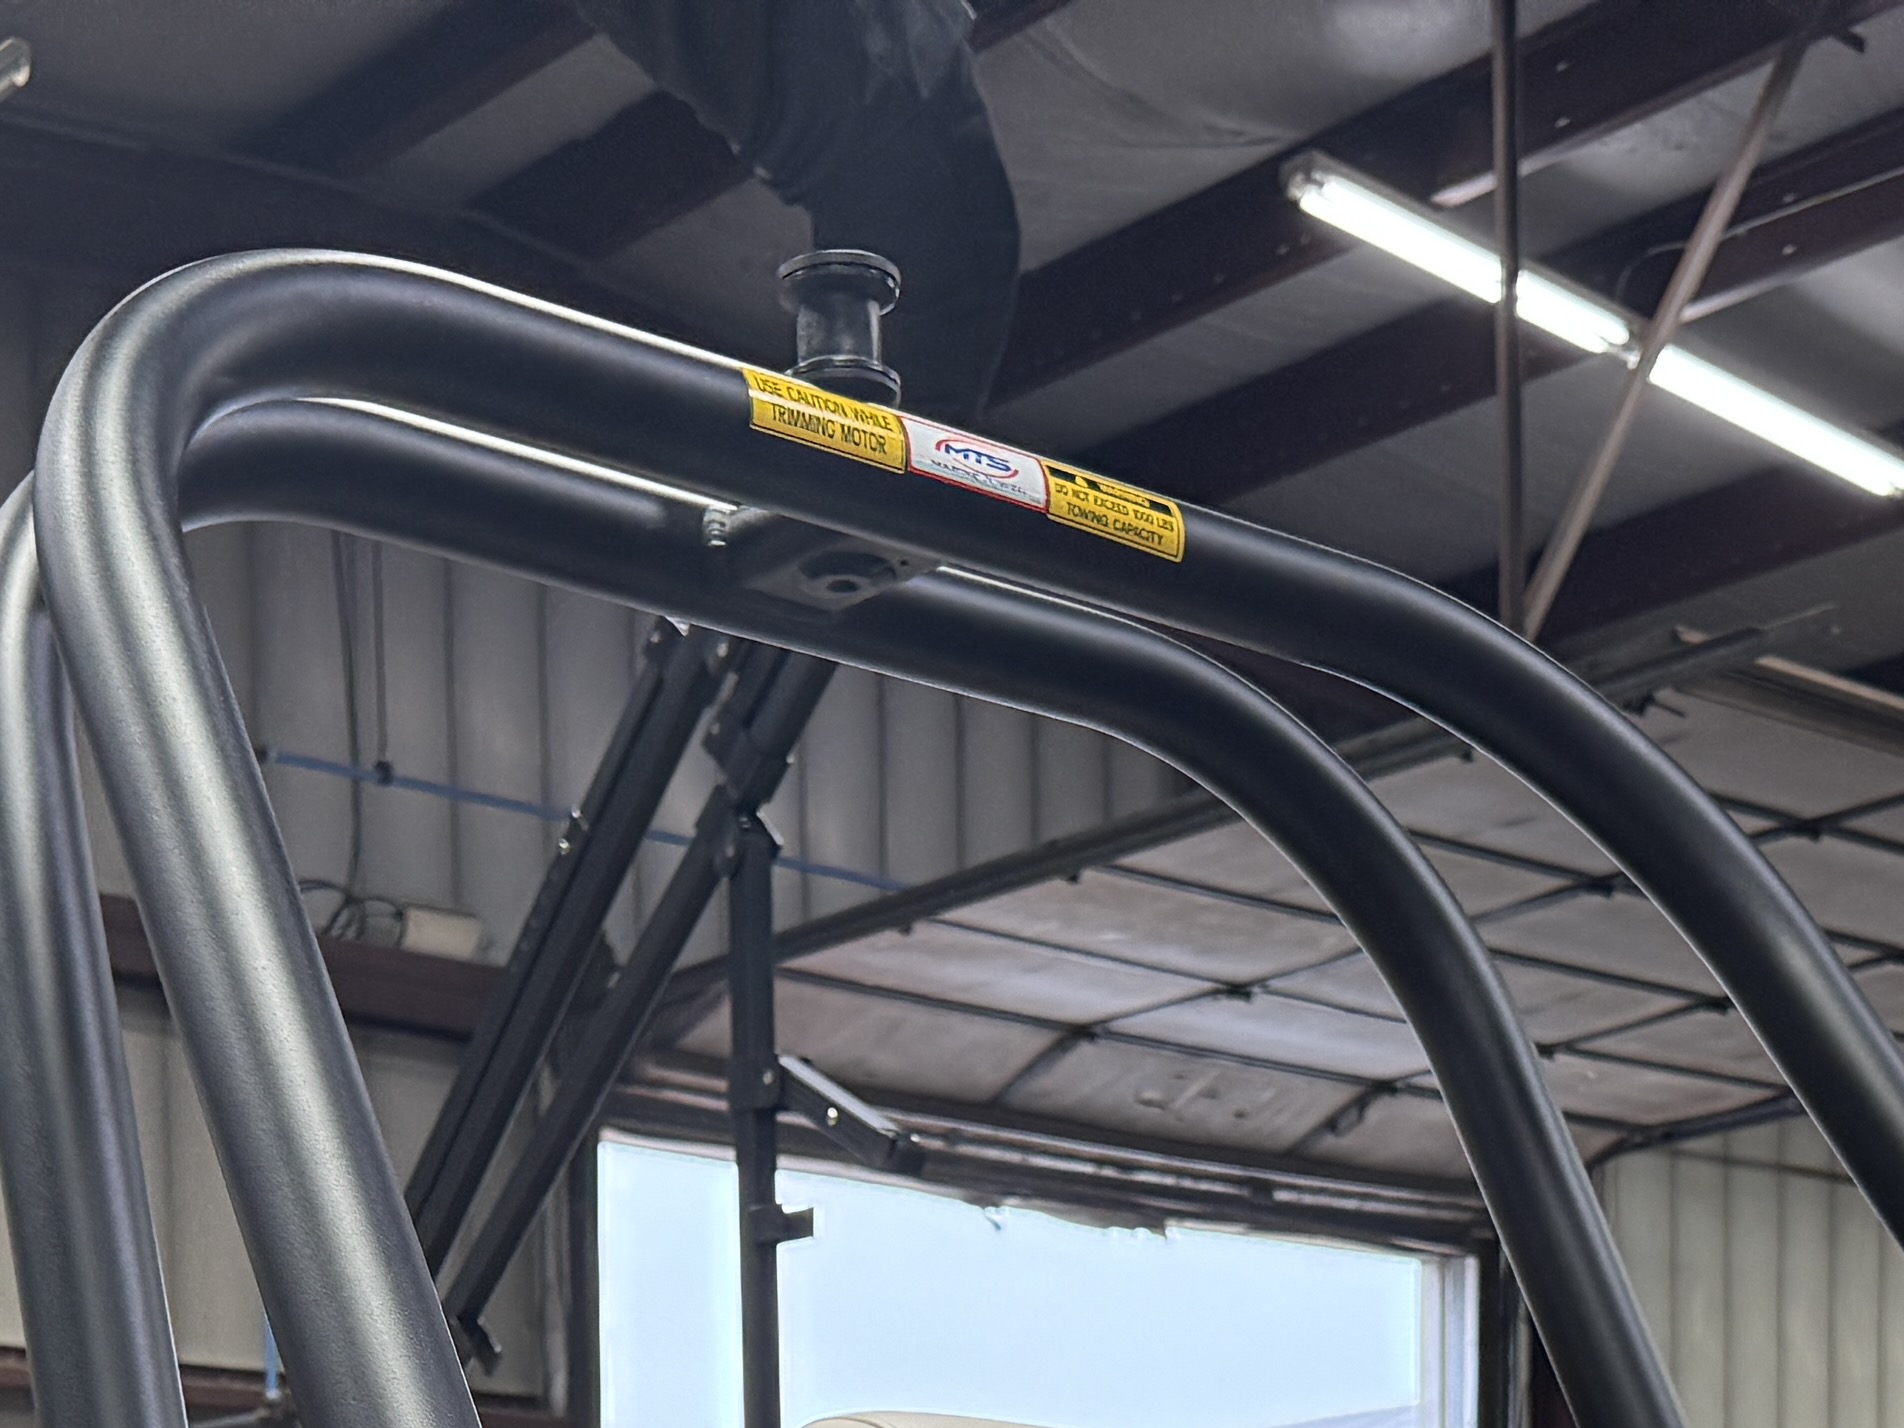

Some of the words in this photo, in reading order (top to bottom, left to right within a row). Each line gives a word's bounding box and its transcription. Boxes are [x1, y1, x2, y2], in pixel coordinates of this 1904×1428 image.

[753, 374, 784, 398] USE
[787, 386, 848, 419] CAUTION
[849, 406, 893, 432] WHILE
[771, 402, 836, 440] TRIMMING
[840, 422, 887, 455] MOTOR
[944, 443, 1012, 473] MTS
[1054, 482, 1069, 497] DO
[1071, 488, 1090, 503] NOT
[1093, 495, 1130, 516] EXCEED
[1065, 501, 1110, 528] TOWING
[1111, 519, 1164, 546] CAPACITY
